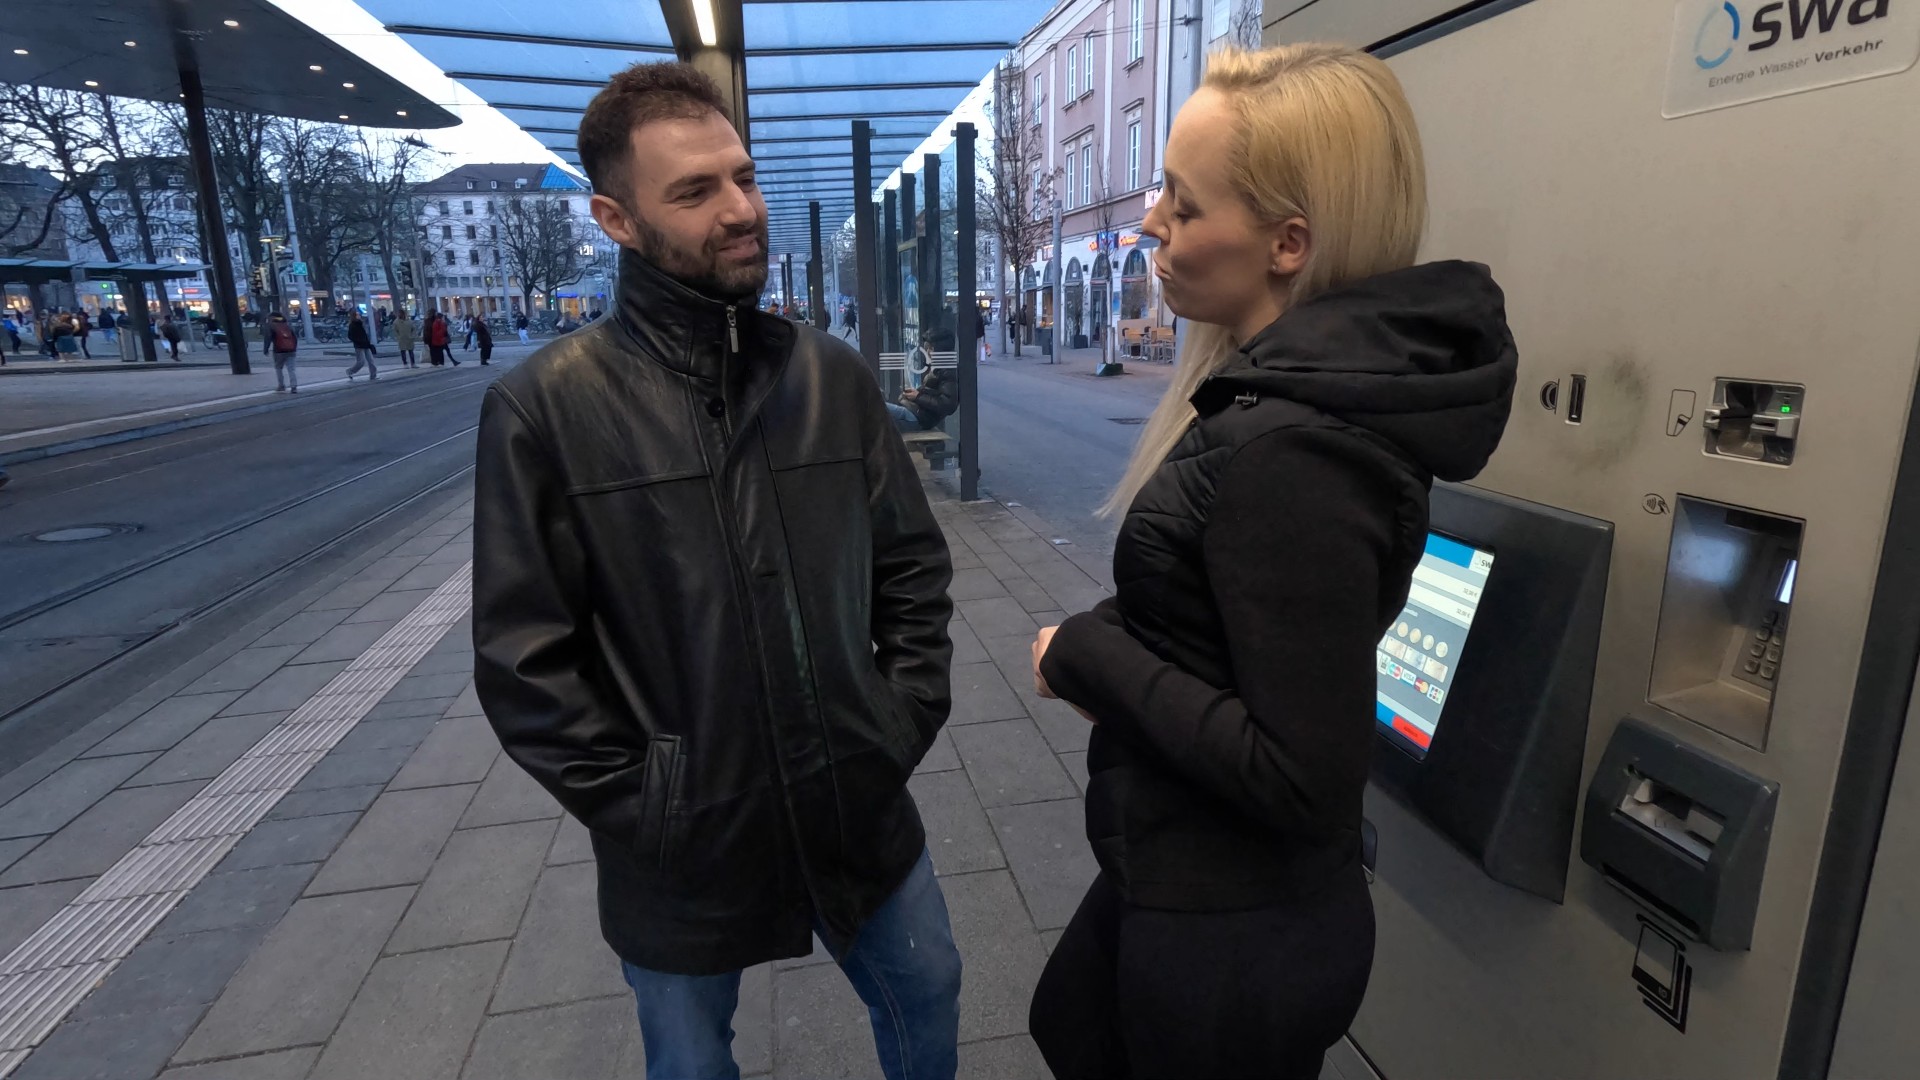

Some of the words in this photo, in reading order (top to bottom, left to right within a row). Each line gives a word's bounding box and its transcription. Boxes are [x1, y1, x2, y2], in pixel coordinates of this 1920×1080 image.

[1709, 70, 1754, 87] Energie
[1760, 58, 1809, 75] Wasser
[1815, 39, 1883, 63] Verkehr
